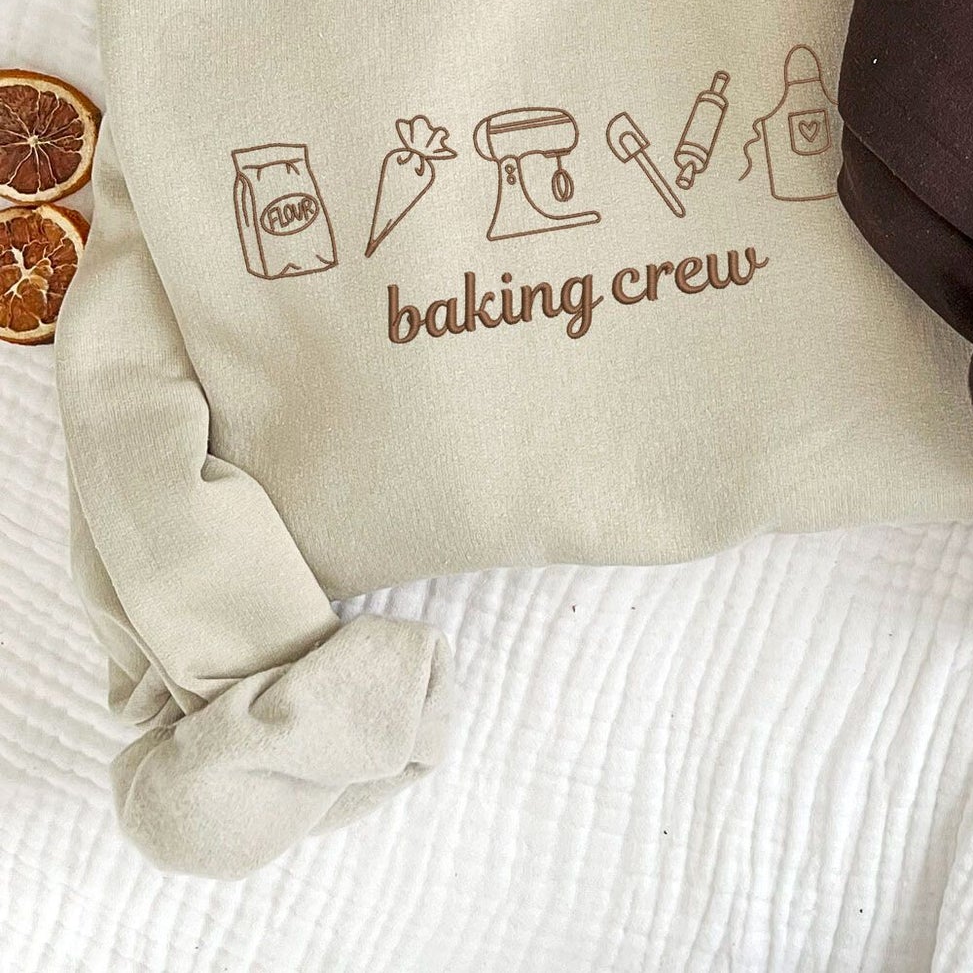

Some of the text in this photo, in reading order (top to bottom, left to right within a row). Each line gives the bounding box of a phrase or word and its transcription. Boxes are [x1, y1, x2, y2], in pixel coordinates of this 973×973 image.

[267, 198, 314, 230] FLOUR
[386, 246, 769, 344] baking crew
